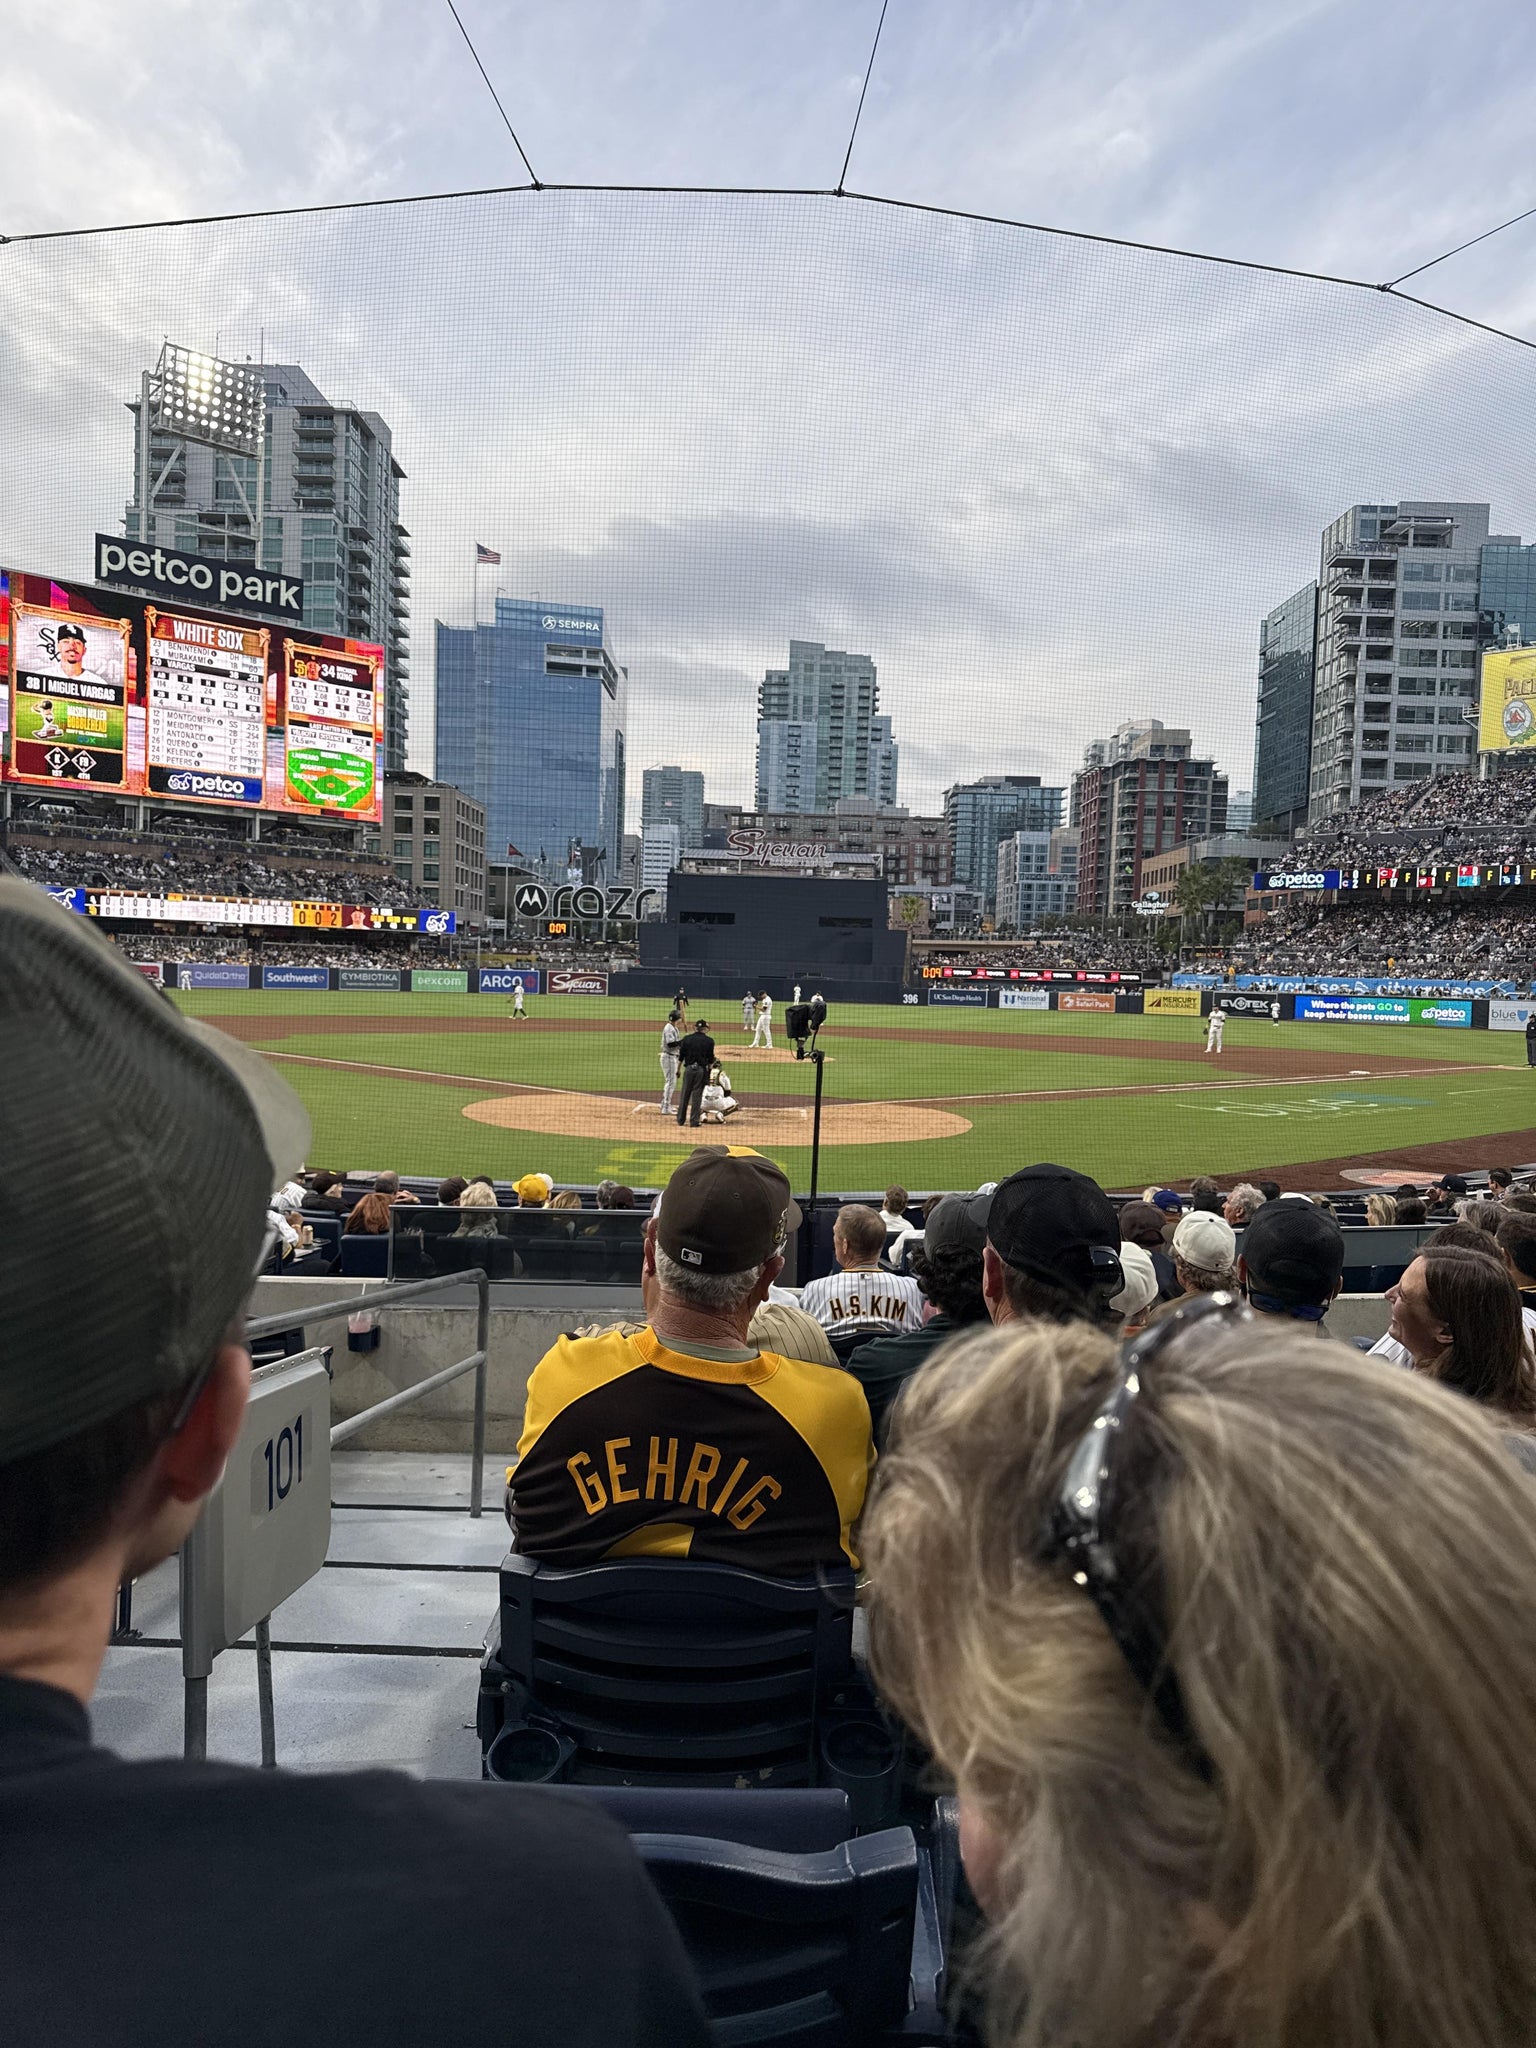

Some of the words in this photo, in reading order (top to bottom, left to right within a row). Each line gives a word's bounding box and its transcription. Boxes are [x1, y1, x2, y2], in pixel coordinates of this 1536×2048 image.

[100, 543, 213, 590] petco
[219, 569, 300, 610] park
[558, 619, 600, 631] SEMPRA
[172, 620, 215, 645] WHITE
[217, 629, 243, 651] SOX
[153, 639, 162, 648] 23
[168, 642, 210, 655] BENINTENDI
[229, 653, 239, 661] DH
[154, 648, 160, 656] 5
[168, 651, 206, 664] MURAKAMI
[152, 657, 162, 667] 20
[166, 660, 196, 672] VARGAS
[321, 664, 335, 678] 34
[26, 676, 40, 690] 3B
[48, 680, 80, 696] MIGUEL
[80, 684, 115, 701] VARGAS
[181, 684, 189, 692] 22
[166, 711, 216, 724] MONTGOMERY
[166, 721, 203, 732] MEIDROTH
[166, 729, 207, 741] ANTONACCI
[166, 739, 191, 748] QUERO
[151, 745, 160, 753] 24
[166, 748, 196, 758] KELENIC
[229, 755, 238, 763] RF
[166, 756, 193, 766] PETERS
[191, 776, 245, 793] petco
[726, 828, 829, 867] Sycuan
[1285, 872, 1325, 887] petco
[1366, 873, 1372, 884] F
[1391, 869, 1397, 878] 7
[1405, 872, 1411, 882] F
[1445, 872, 1451, 881] F
[1487, 871, 1493, 880] F
[552, 884, 657, 921] razr
[1131, 900, 1170, 910] Gallagher
[1136, 907, 1165, 916] Square
[299, 911, 306, 924] 0
[315, 912, 321, 925] 0
[330, 913, 337, 926] 2
[266, 972, 318, 984] Southwest
[923, 967, 941, 978] 0:09
[481, 975, 523, 988] ARCO
[551, 973, 602, 993] Sycuan
[903, 993, 918, 1004] 396
[1311, 1000, 1340, 1009] Where
[1340, 1001, 1355, 1010] the
[1356, 1002, 1375, 1012] pets
[1376, 1003, 1393, 1011] GO
[1393, 1003, 1404, 1012] to
[1304, 1009, 1325, 1020] keep
[1326, 1010, 1347, 1020] their
[1347, 1011, 1373, 1020] bases
[1373, 1013, 1410, 1022] covered
[1434, 1007, 1466, 1019] petco
[1491, 1009, 1517, 1019] blue
[264, 1414, 303, 1512] 101
[566, 1436, 782, 1530] GEHRIG
